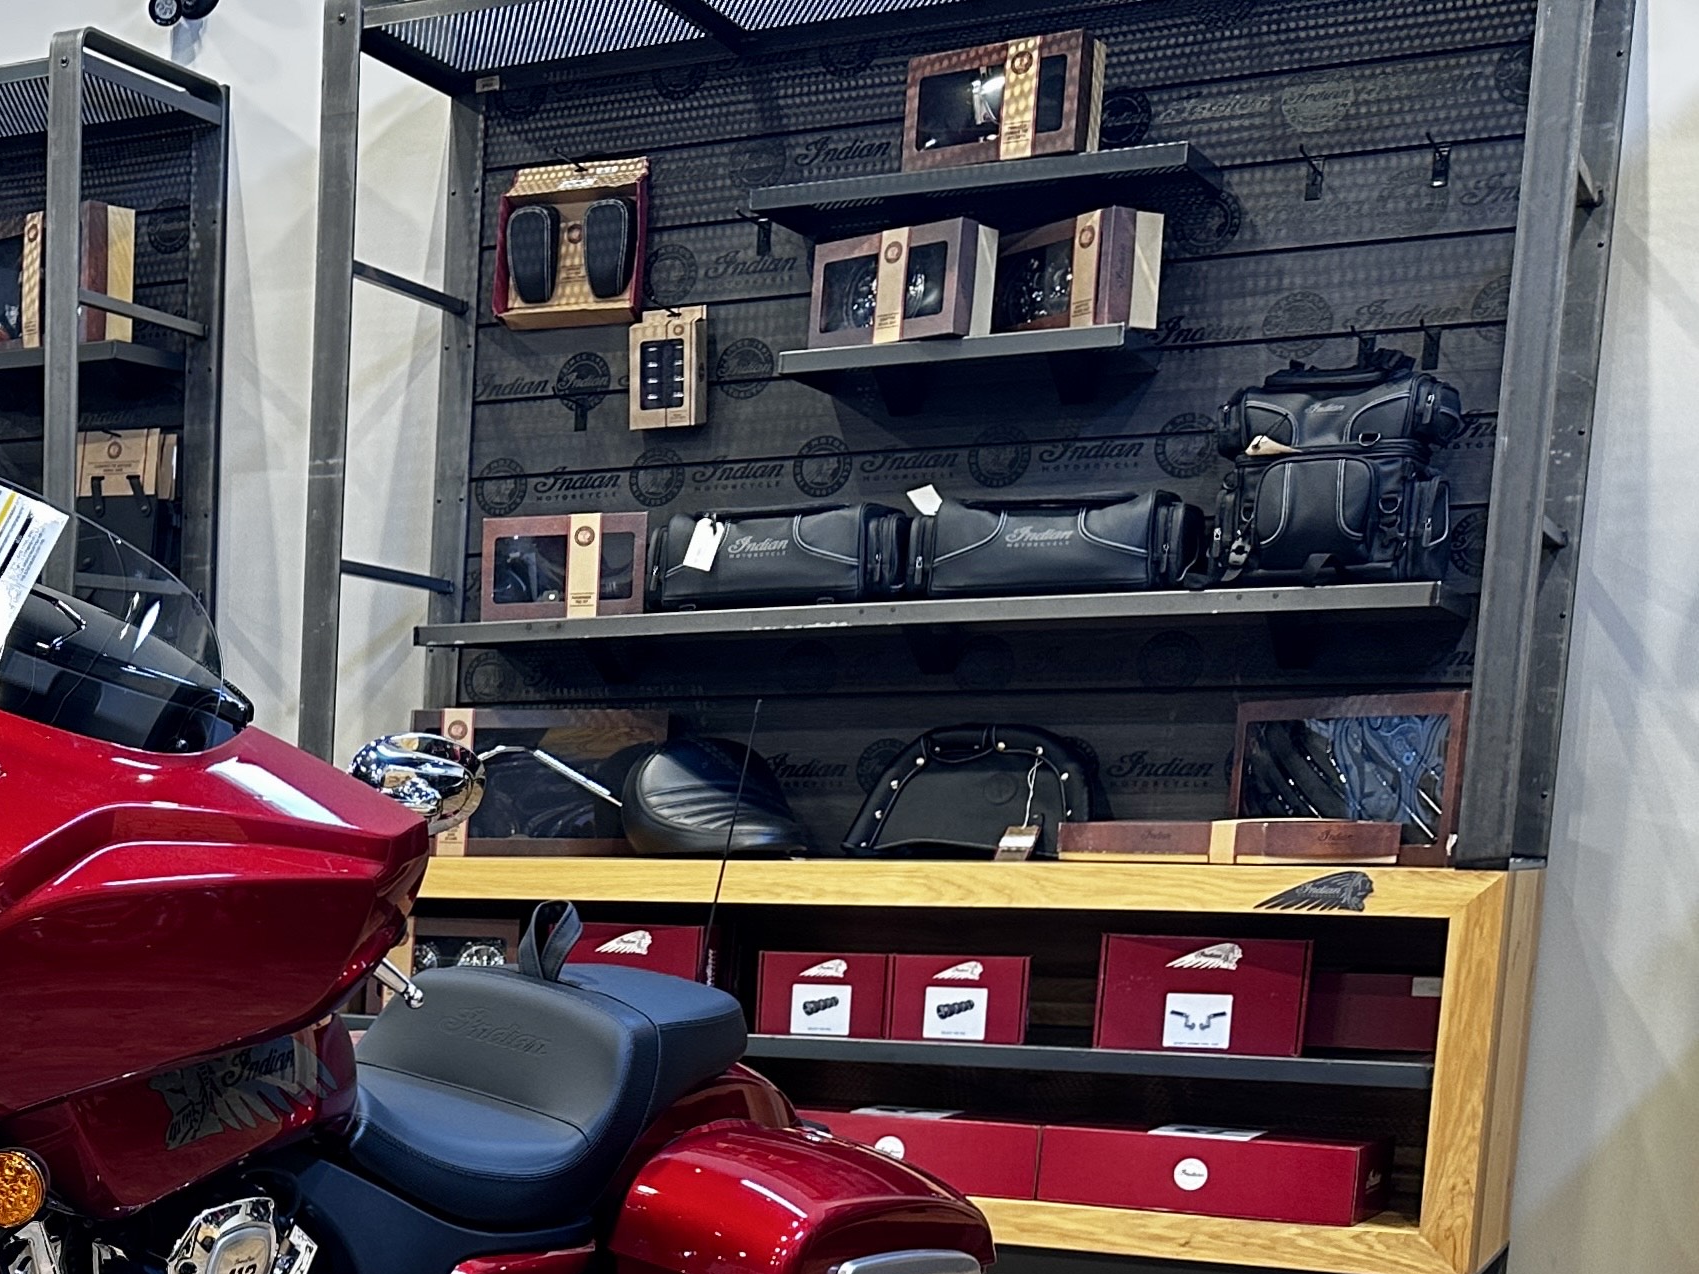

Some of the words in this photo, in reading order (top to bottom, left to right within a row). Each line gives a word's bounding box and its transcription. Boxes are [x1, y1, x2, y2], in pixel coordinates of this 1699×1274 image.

[795, 137, 891, 166] Indian
[704, 250, 797, 278] Indian
[860, 449, 959, 473] Indian
[1039, 438, 1145, 463] Indian
[534, 466, 621, 494] Indian
[692, 455, 784, 485] Indian
[727, 535, 789, 554] Indian
[1005, 525, 1074, 543] Indian
[1106, 750, 1213, 778] Indian
[1295, 882, 1341, 895] Indian
[440, 1006, 553, 1057] Indian
[221, 1048, 294, 1088] Indian
